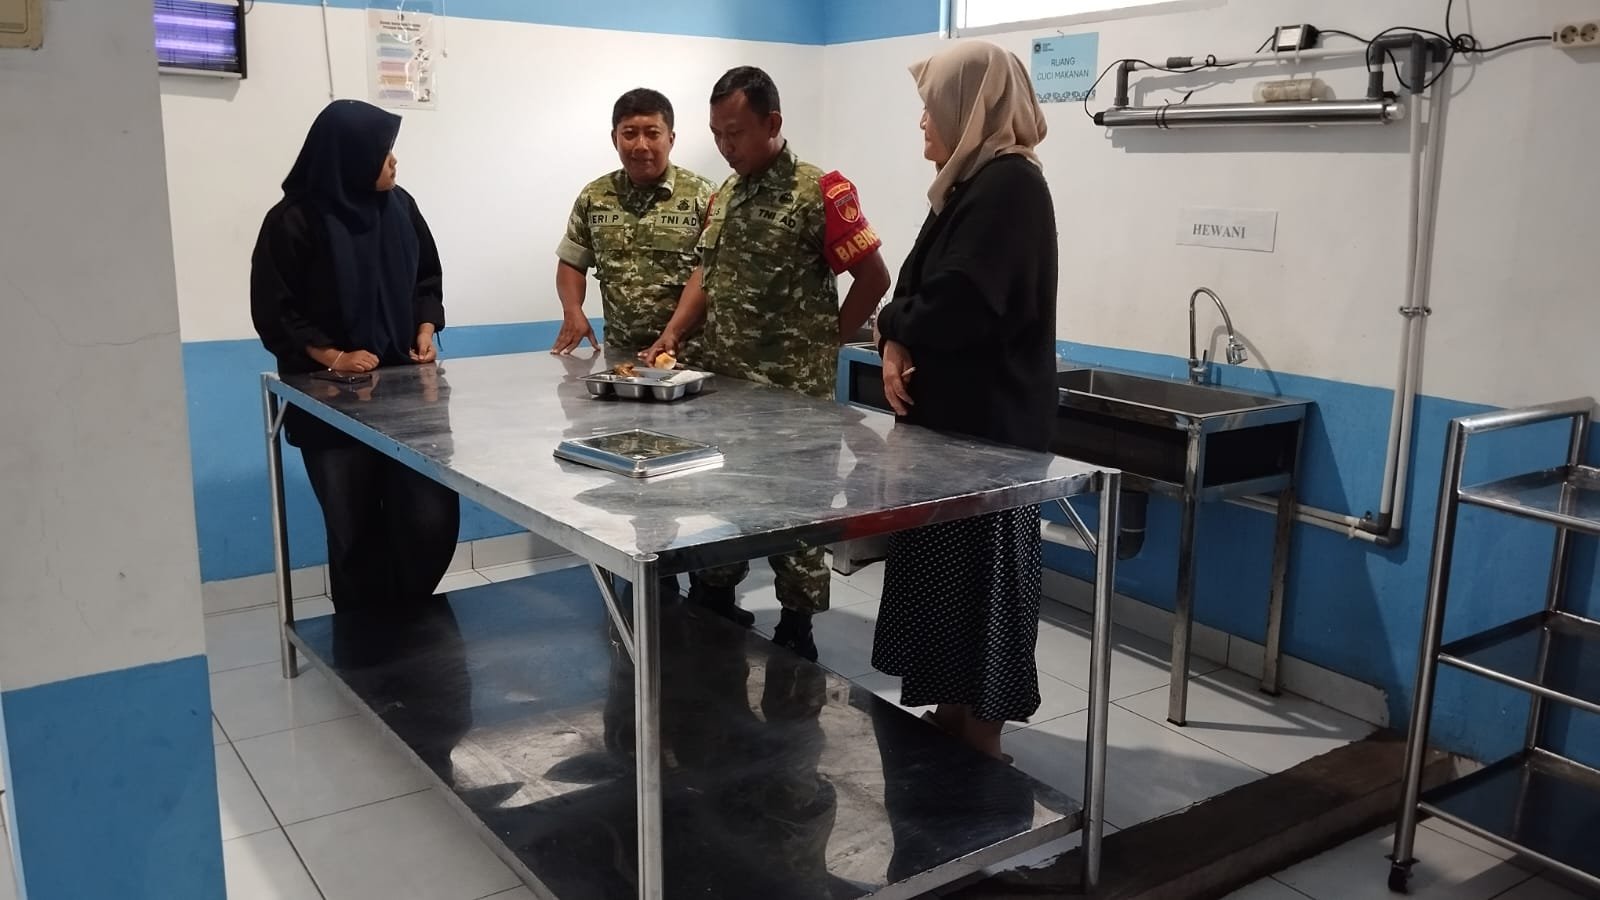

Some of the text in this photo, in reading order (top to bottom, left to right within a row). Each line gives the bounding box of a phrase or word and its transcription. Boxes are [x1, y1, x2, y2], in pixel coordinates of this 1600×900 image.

[1051, 57, 1076, 67] RUANG
[1037, 69, 1089, 80] CUCI MAKANAN
[612, 214, 619, 223] P
[661, 215, 697, 227] TNI AD
[759, 208, 796, 229] TNI AD
[1192, 223, 1246, 239] HEWANI
